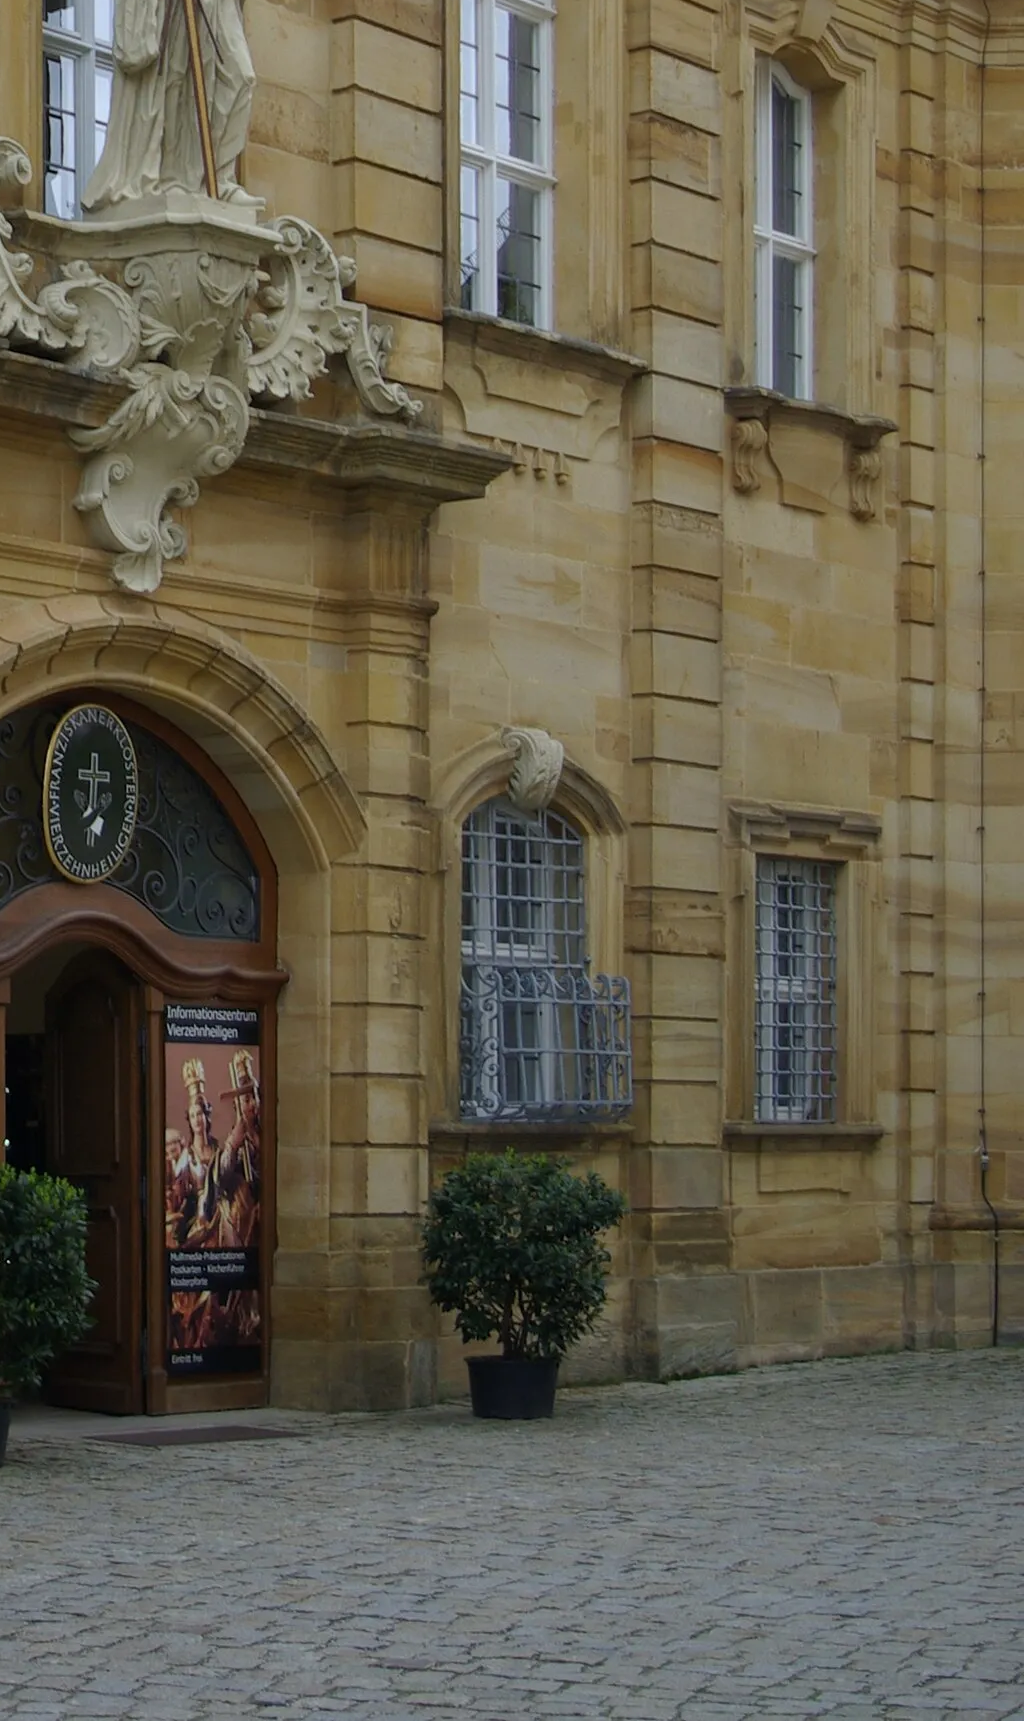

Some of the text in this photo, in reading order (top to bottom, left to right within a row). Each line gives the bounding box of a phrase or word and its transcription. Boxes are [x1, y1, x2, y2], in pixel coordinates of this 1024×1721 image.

[49, 805, 136, 878] VIERZEHNHEILIGEN
[166, 1005, 257, 1022] Informationszentrum
[166, 1023, 238, 1041] Vierzehnheiligen
